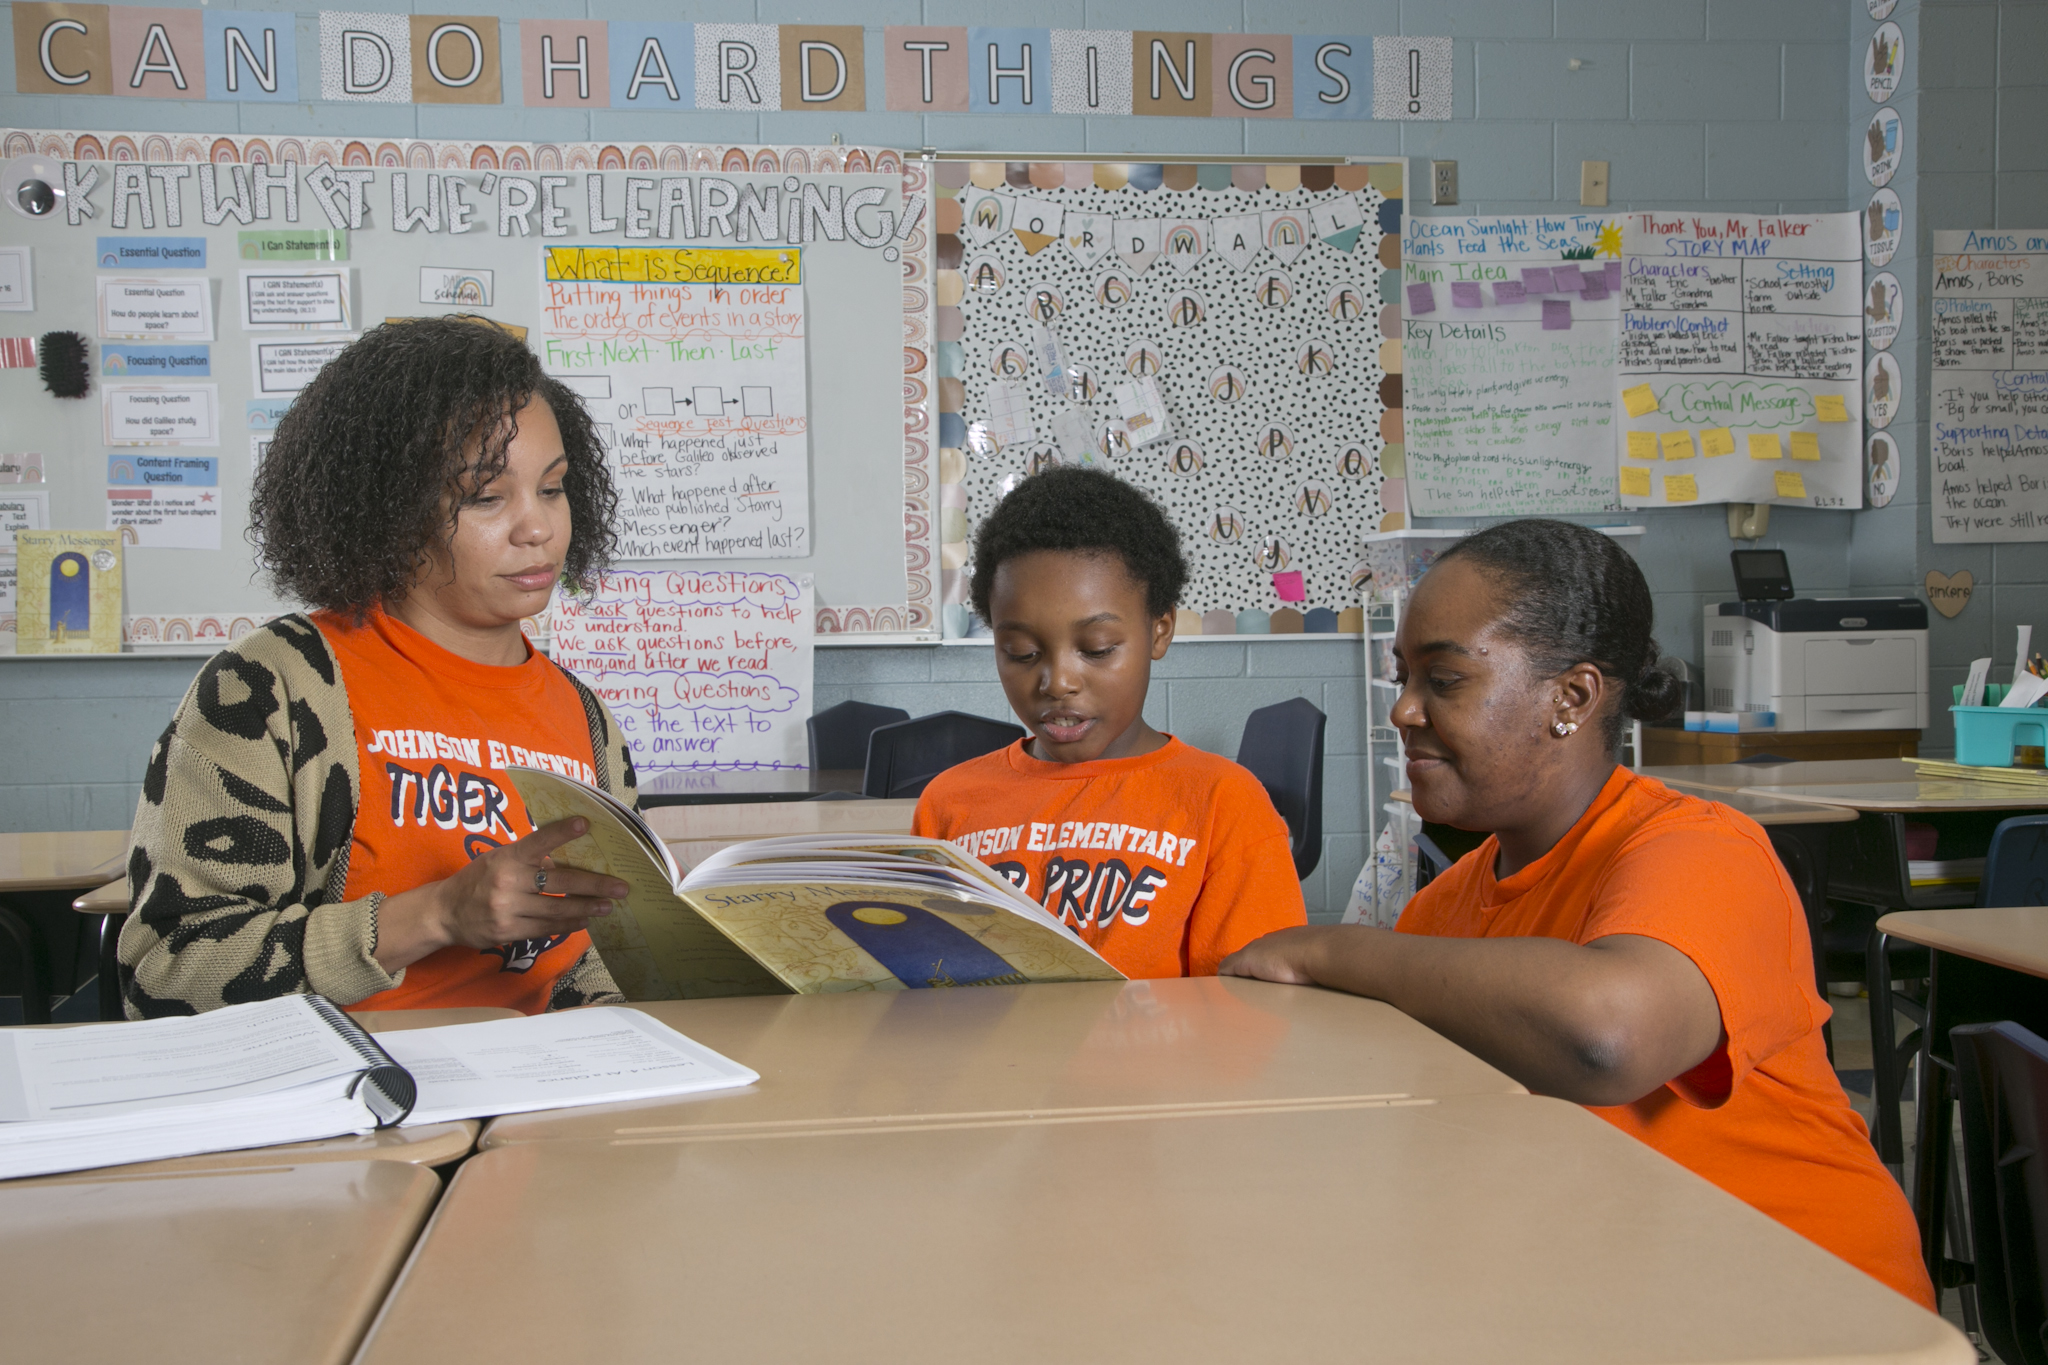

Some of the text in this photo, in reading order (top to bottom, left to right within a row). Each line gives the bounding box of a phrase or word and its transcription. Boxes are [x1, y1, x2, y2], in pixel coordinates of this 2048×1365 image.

[38, 19, 1421, 114] CAN DO HARD THINGS!
[1870, 77, 1893, 91] PENCIL
[1872, 158, 1893, 177] DRINK
[198, 160, 374, 230] WHAT
[391, 172, 568, 236] WE'RE
[587, 174, 926, 262] LEARNING!
[1410, 219, 1464, 239] Ocean
[1536, 218, 1565, 233] How
[1570, 216, 1603, 237] Tiny
[267, 241, 283, 251] Can
[1403, 239, 1444, 256] Plants
[1458, 239, 1486, 254] Feed
[1500, 237, 1530, 253] the
[1665, 238, 1770, 257] STORY MAP
[1869, 240, 1894, 255] TISSUE
[1963, 231, 2018, 251] Amos
[120, 247, 201, 259] Essential Question
[550, 248, 795, 299] What is Sequence?
[1406, 263, 1508, 283] Main Idea
[1628, 258, 1710, 278] Characters
[1956, 255, 2031, 272] Characters
[977, 262, 995, 286] A
[1777, 261, 1835, 292] Setting
[124, 288, 185, 297] Essential Question
[550, 283, 791, 315] Putting things in order
[1104, 277, 1119, 303] C
[1267, 276, 1280, 305] E
[111, 310, 199, 320] How do people learn about
[1038, 291, 1055, 320] B
[1182, 296, 1198, 326] D
[144, 320, 169, 331] space?
[545, 306, 578, 329] The
[584, 306, 631, 329] order
[638, 303, 657, 328] of
[660, 308, 720, 327] events
[727, 308, 745, 327] in
[751, 314, 761, 326] a
[1407, 321, 1507, 349] Key Details
[1867, 325, 1897, 338] QUESTION
[127, 355, 208, 368] Focusing Question
[129, 395, 191, 404] Focusing Question
[1682, 390, 1733, 411] Central
[1741, 392, 1801, 420] Message
[618, 402, 638, 420] or
[1873, 404, 1888, 417] YES
[125, 416, 197, 427] How did Galileo study
[741, 416, 807, 430] Questions
[150, 427, 174, 437] space?
[661, 434, 725, 450] happened
[733, 434, 764, 450] just
[1936, 422, 2010, 450] Supporting
[137, 457, 210, 471] Content Framing
[620, 450, 666, 465] before
[675, 449, 715, 463] Galileo
[143, 472, 183, 483] Question
[620, 463, 701, 478] the stars?
[631, 473, 777, 504] What happened after
[1874, 481, 1885, 496] NO
[617, 499, 729, 520] Galileo published
[1974, 516, 2004, 529] were
[22, 534, 117, 546] Starry Messenger
[619, 526, 805, 557] Which event happened last?
[667, 572, 786, 596] Questions
[1928, 585, 1970, 599] sincere
[595, 599, 801, 623] ask questions to help
[554, 621, 574, 631] us
[595, 631, 797, 659] ask questions before,
[645, 652, 689, 669] after
[698, 660, 721, 672] we
[674, 675, 771, 703] Questions
[651, 710, 771, 733] the text to
[367, 728, 481, 767] JOHNSON
[386, 762, 517, 841] TIGER
[1027, 821, 1196, 867] ELEMENTARY
[705, 891, 796, 909] Starry
[1043, 856, 1167, 928] PRIDE
